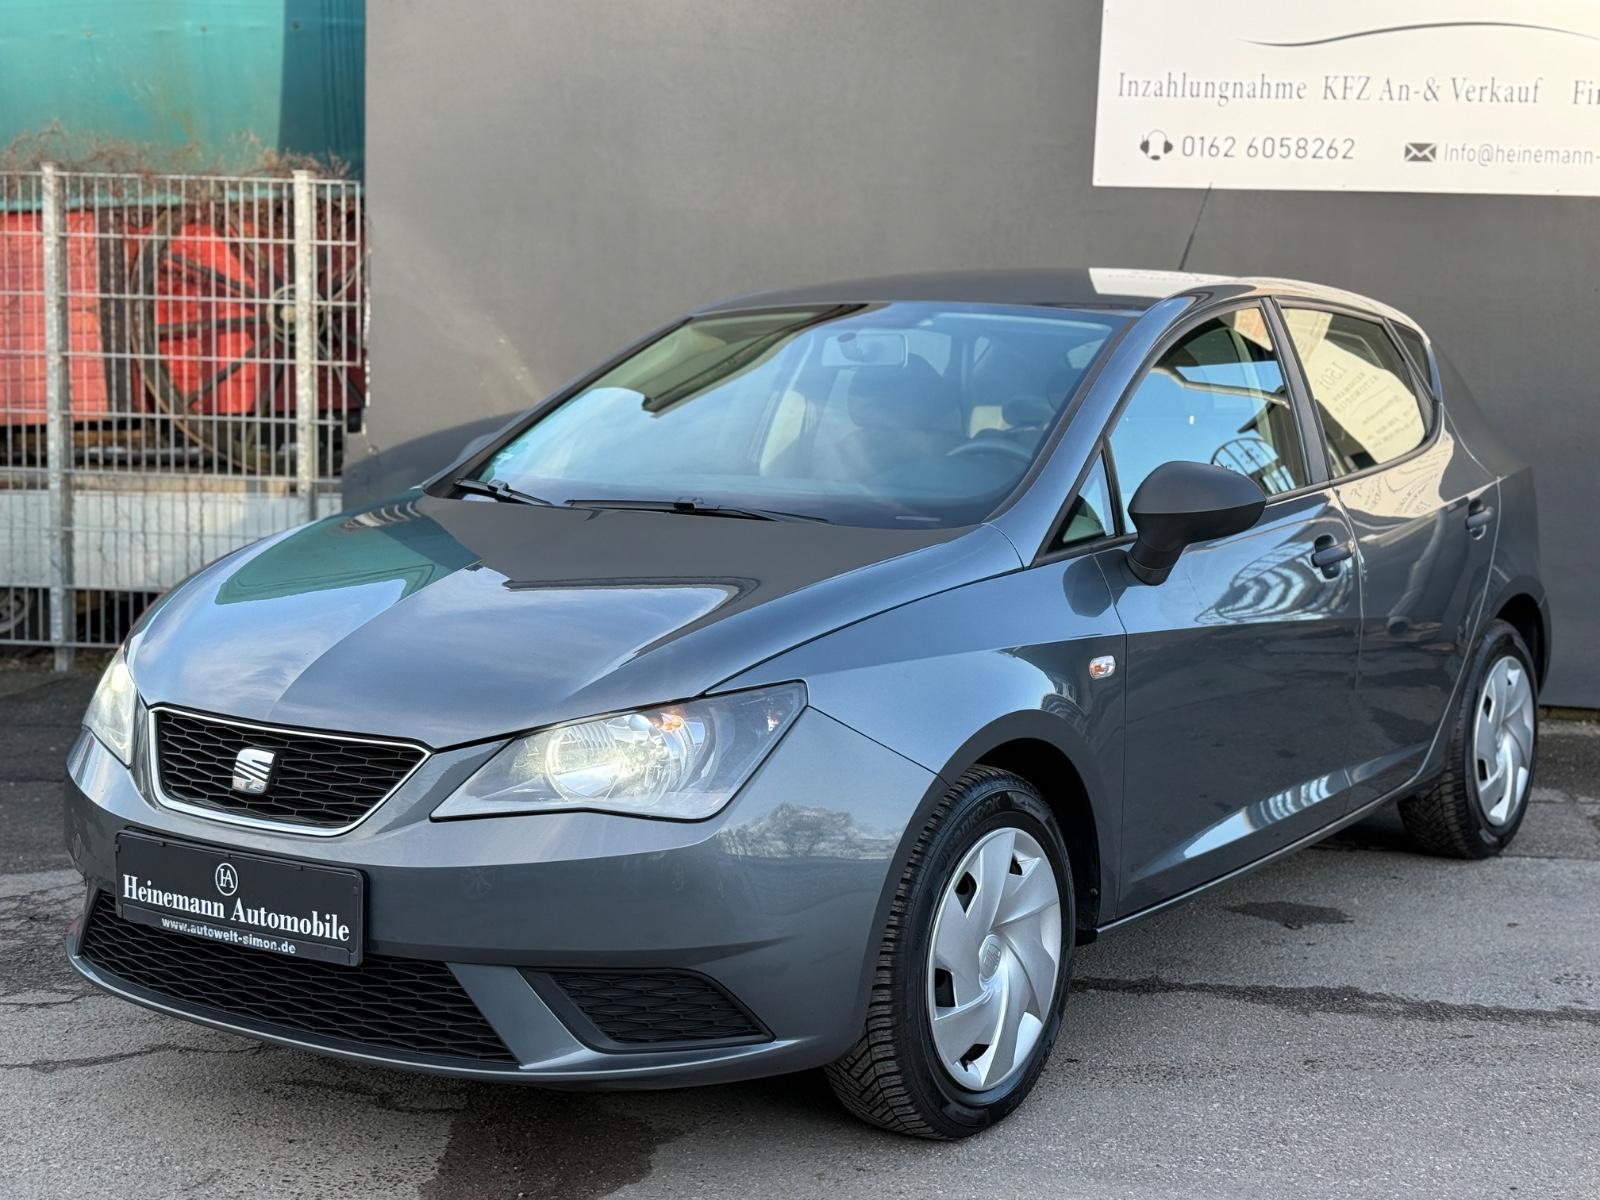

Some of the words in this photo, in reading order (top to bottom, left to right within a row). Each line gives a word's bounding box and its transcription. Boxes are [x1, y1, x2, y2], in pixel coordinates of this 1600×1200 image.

[1118, 72, 1307, 107] Inzahlungnahme
[1322, 75, 1371, 101] KFZ
[1451, 76, 1543, 104] Verkauf
[1181, 136, 1237, 158] 0162
[1246, 137, 1356, 160] 6058262
[122, 874, 226, 920] Heinemann
[230, 897, 350, 941] Automobile
[161, 916, 297, 954] www.autowelt-simon.de
